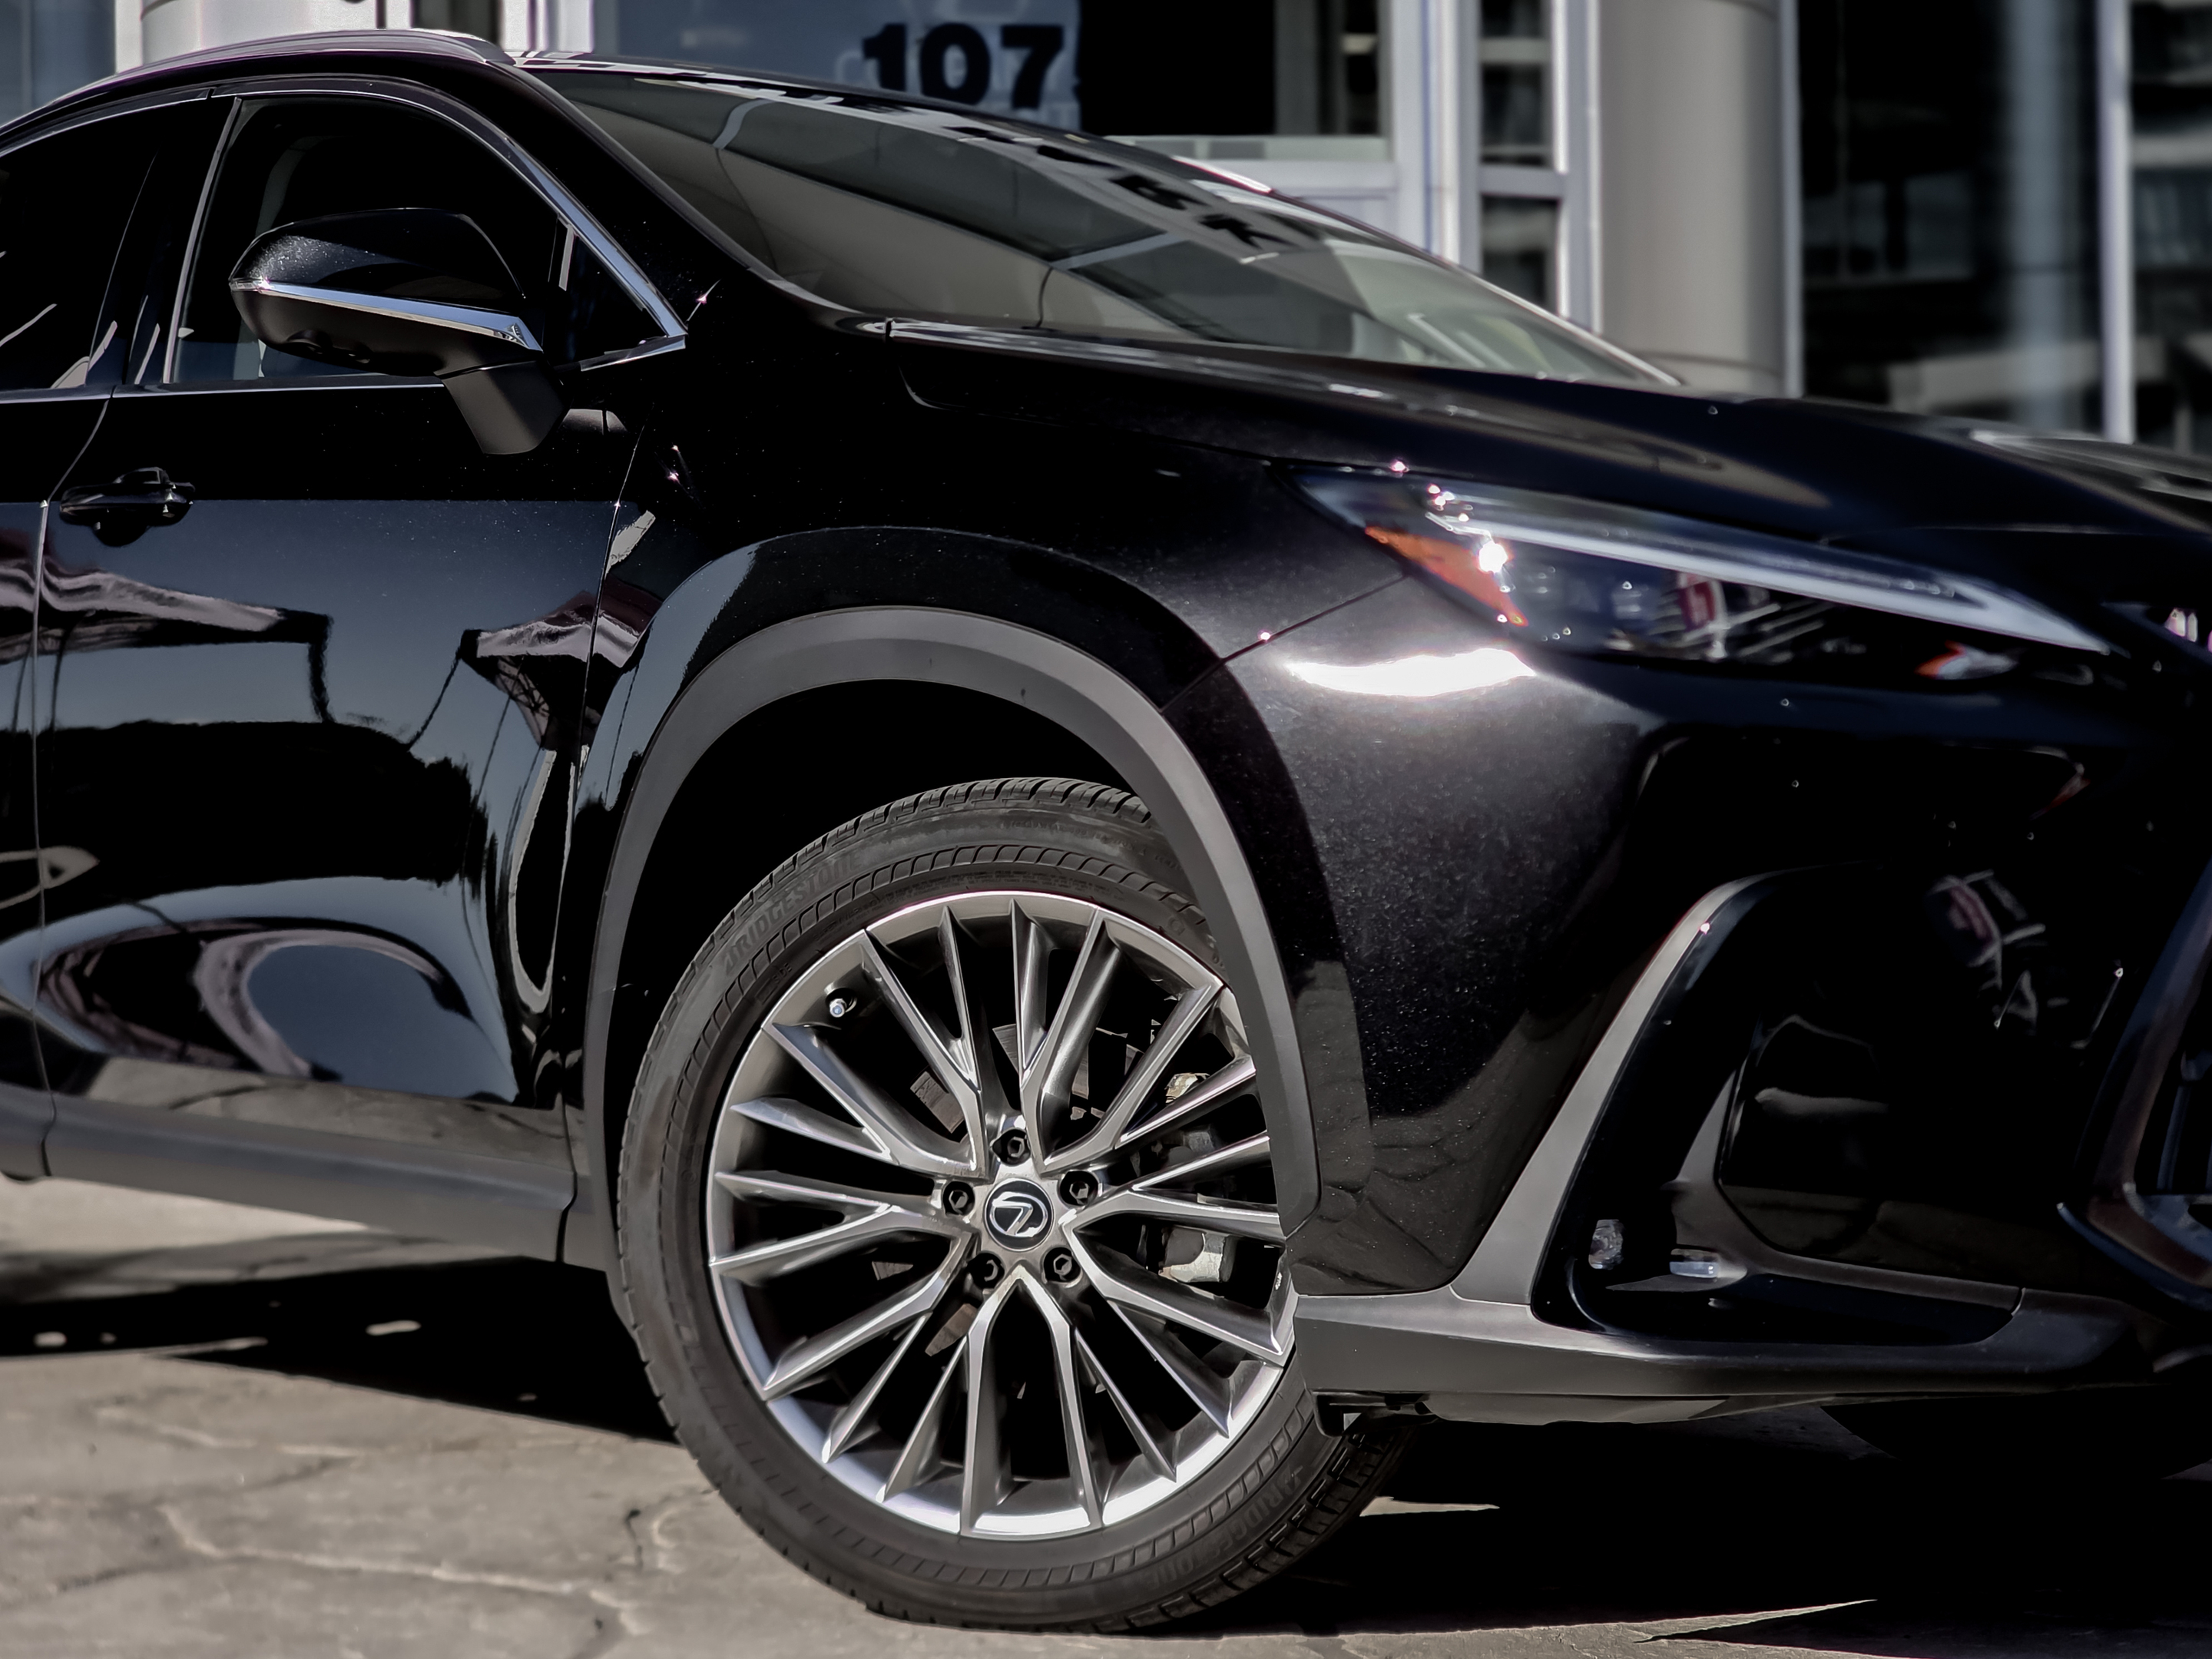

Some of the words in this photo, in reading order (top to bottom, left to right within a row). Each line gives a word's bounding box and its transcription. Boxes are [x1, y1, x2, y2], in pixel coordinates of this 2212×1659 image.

[863, 22, 1065, 109] 107
[722, 853, 861, 975] BRIDGESTONE
[772, 963, 793, 985] SIDE
[1147, 1463, 1302, 1590] BRIDGESTONE
